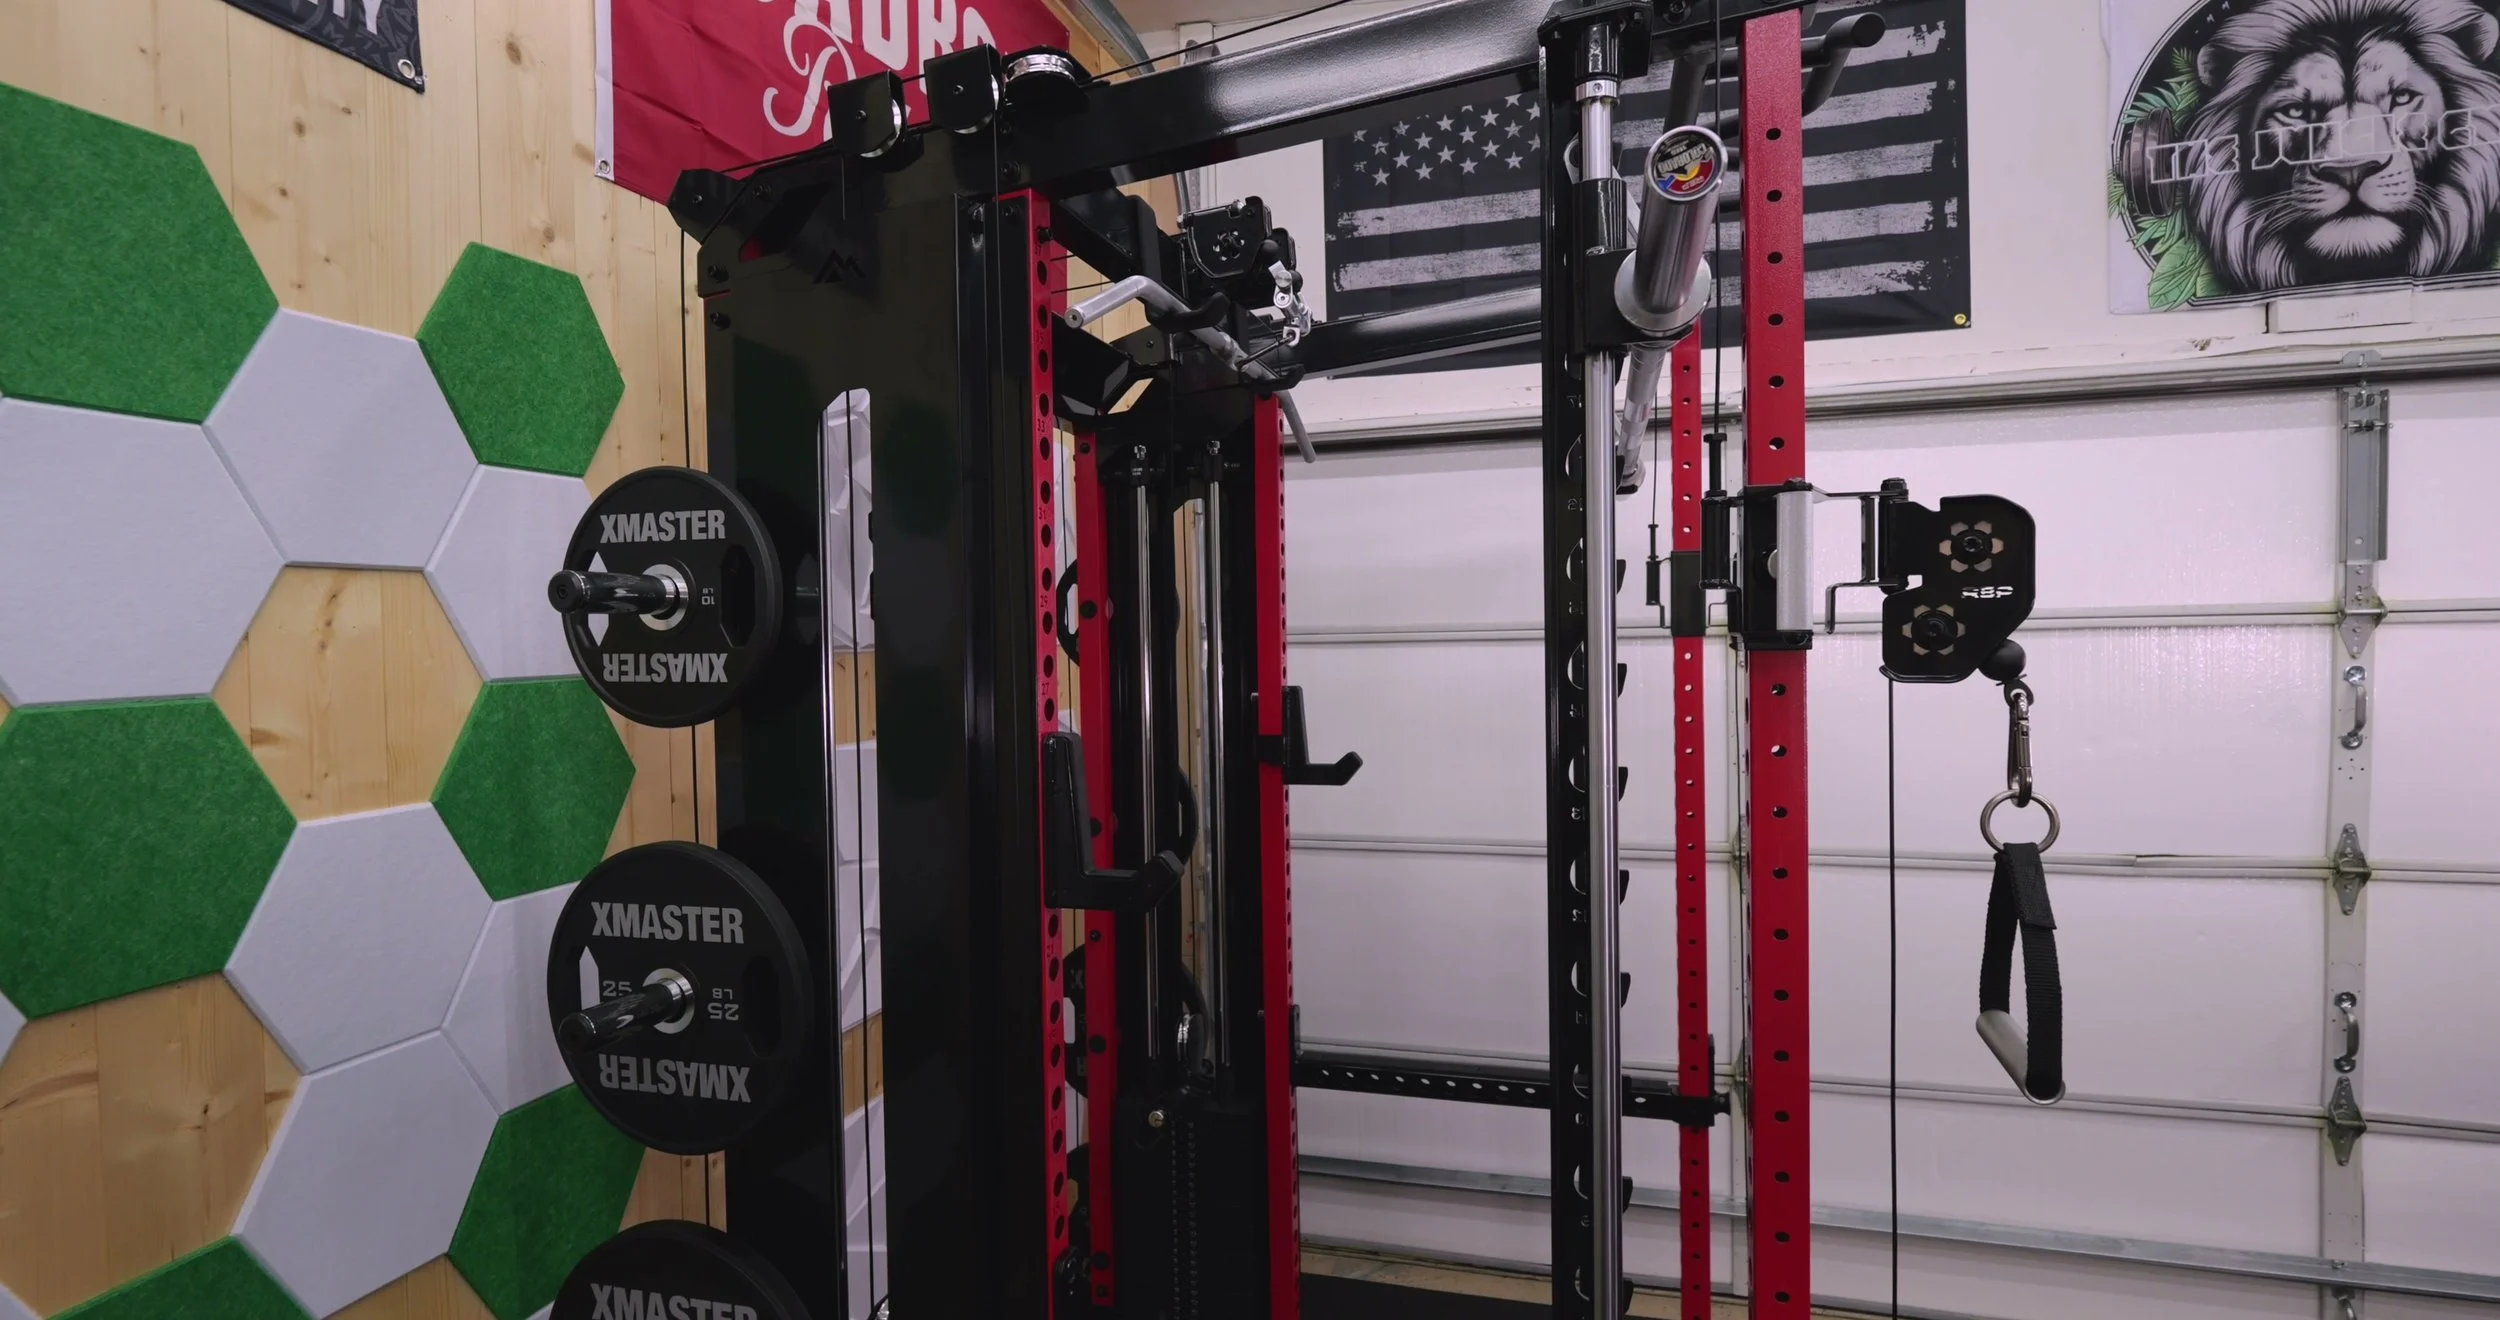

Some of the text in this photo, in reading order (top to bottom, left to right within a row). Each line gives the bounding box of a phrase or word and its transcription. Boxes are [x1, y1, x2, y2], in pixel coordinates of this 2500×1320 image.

[600, 509, 726, 544] XMASTER
[701, 596, 716, 605] 10
[602, 653, 728, 683] XMASTER
[591, 902, 744, 944] XMASTER
[602, 980, 632, 996] 25
[712, 988, 733, 999] LB
[707, 1003, 739, 1021] 25
[598, 1053, 751, 1102] XMASTER
